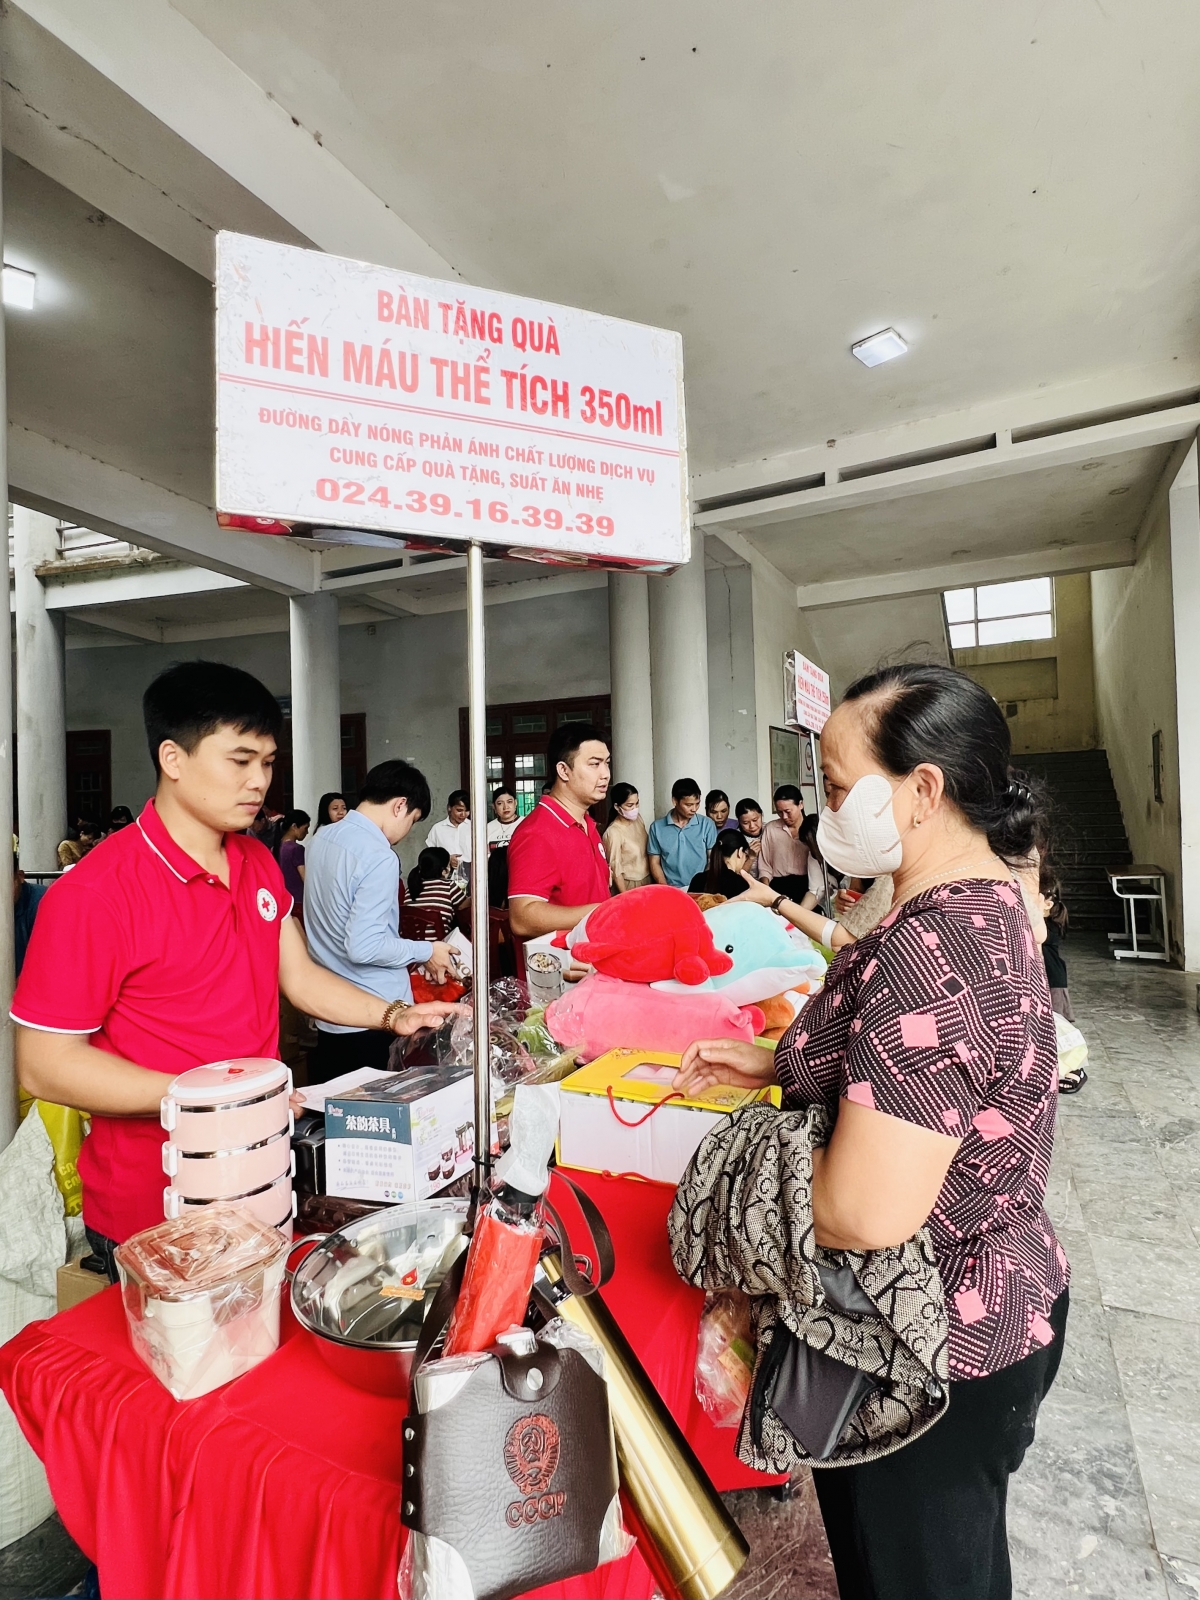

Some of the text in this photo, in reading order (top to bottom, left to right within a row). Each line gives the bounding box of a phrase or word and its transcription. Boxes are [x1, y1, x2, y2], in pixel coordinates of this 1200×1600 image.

[378, 285, 560, 356] BÀN TẶNG QUÀ
[245, 319, 662, 436] HIẾN MÁU THỂ TÍCH 350ml
[259, 408, 655, 485] ĐƯỜNG DÂY NÓNG PHẢN ÁNH CHẤT LƯỢNG DỊCH VỤ
[330, 447, 603, 502] CUNG CẤP QUÀ TẶNG, SUẤT ĂN NHẸ
[316, 476, 615, 537] 024.39.16.39.39
